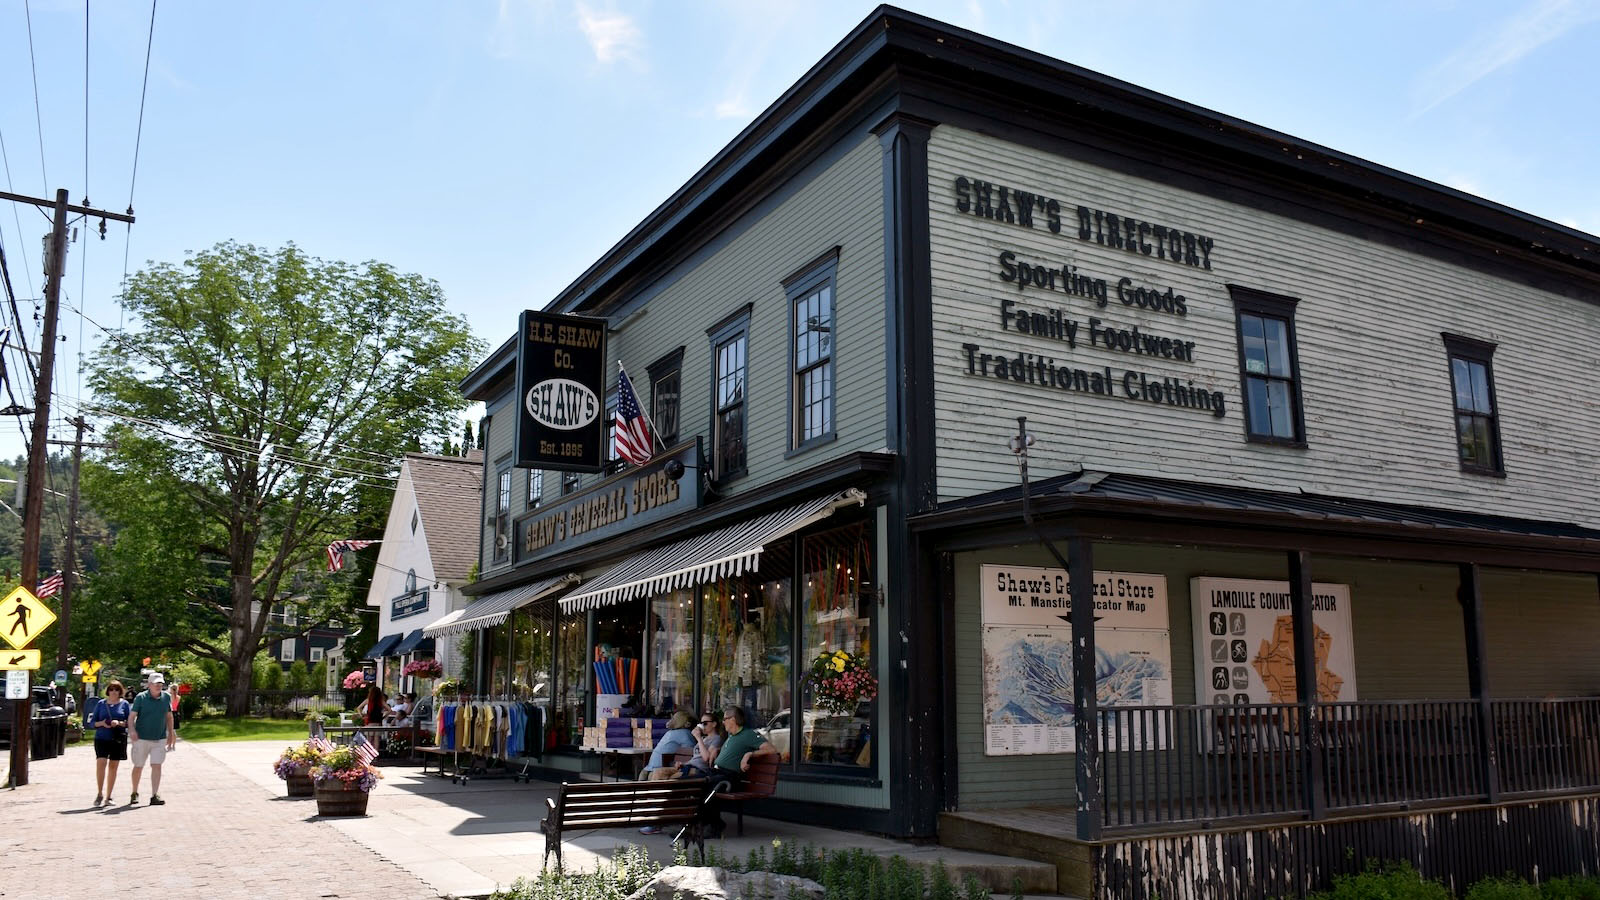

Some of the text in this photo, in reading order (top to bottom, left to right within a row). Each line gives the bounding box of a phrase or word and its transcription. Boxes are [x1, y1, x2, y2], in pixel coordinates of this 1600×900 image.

[955, 176, 1214, 271] SHAW'S DIRECTORY
[999, 250, 1187, 316] Sporting Goods
[528, 320, 601, 349] H.E. SHAW
[1001, 299, 1196, 362] Family Footwear
[554, 349, 575, 370] Co.
[962, 343, 1226, 418] Traditional Clothing
[530, 382, 595, 426] SHAW'S
[539, 440, 583, 457] Est. 1895
[525, 471, 680, 552] SHAW'S GENERAL STORE
[997, 572, 1154, 599] Shaw's Geral Store
[1211, 589, 1337, 611] LAMOILLE COUNT ATOR
[1008, 595, 1146, 613] Mt. Mansfie cator Map
